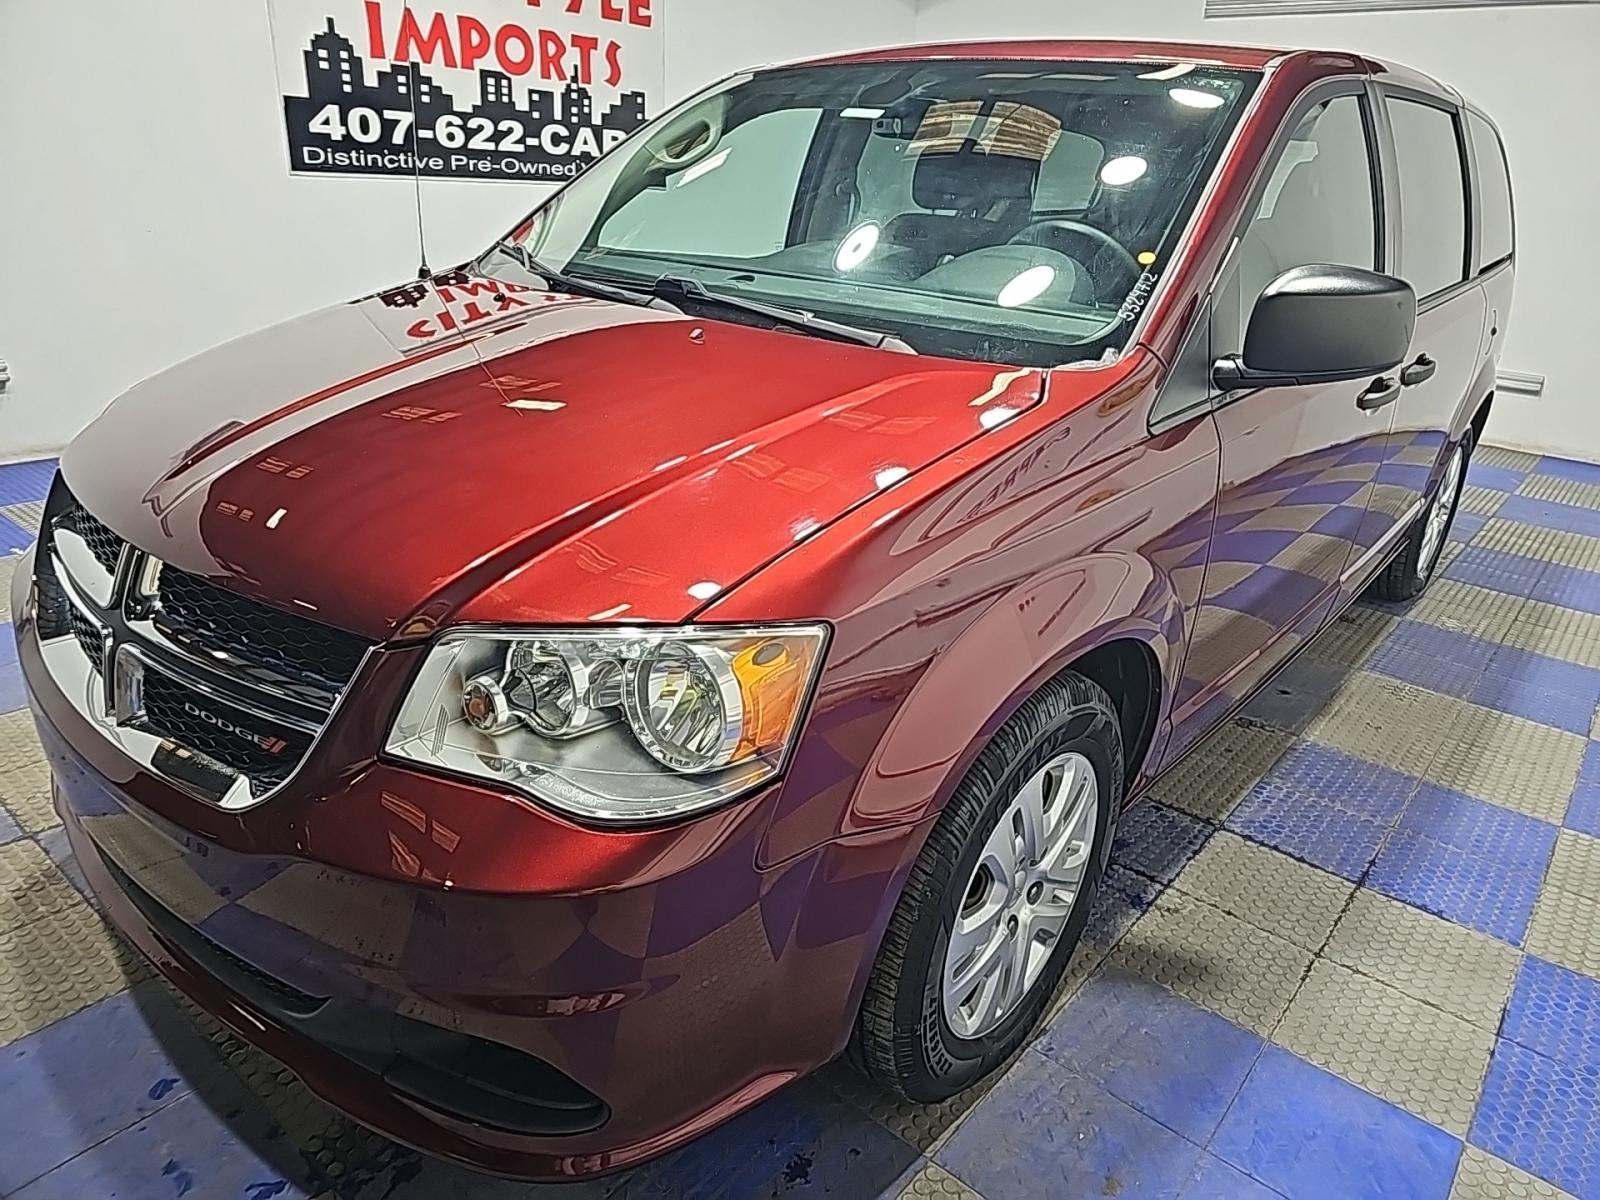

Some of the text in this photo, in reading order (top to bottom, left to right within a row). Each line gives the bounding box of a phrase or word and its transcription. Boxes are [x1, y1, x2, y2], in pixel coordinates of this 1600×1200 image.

[365, 1, 622, 87] IMPORTS
[303, 147, 443, 170] Distinctive
[451, 155, 577, 177] Pre-Owned
[185, 702, 268, 748] DODGE
